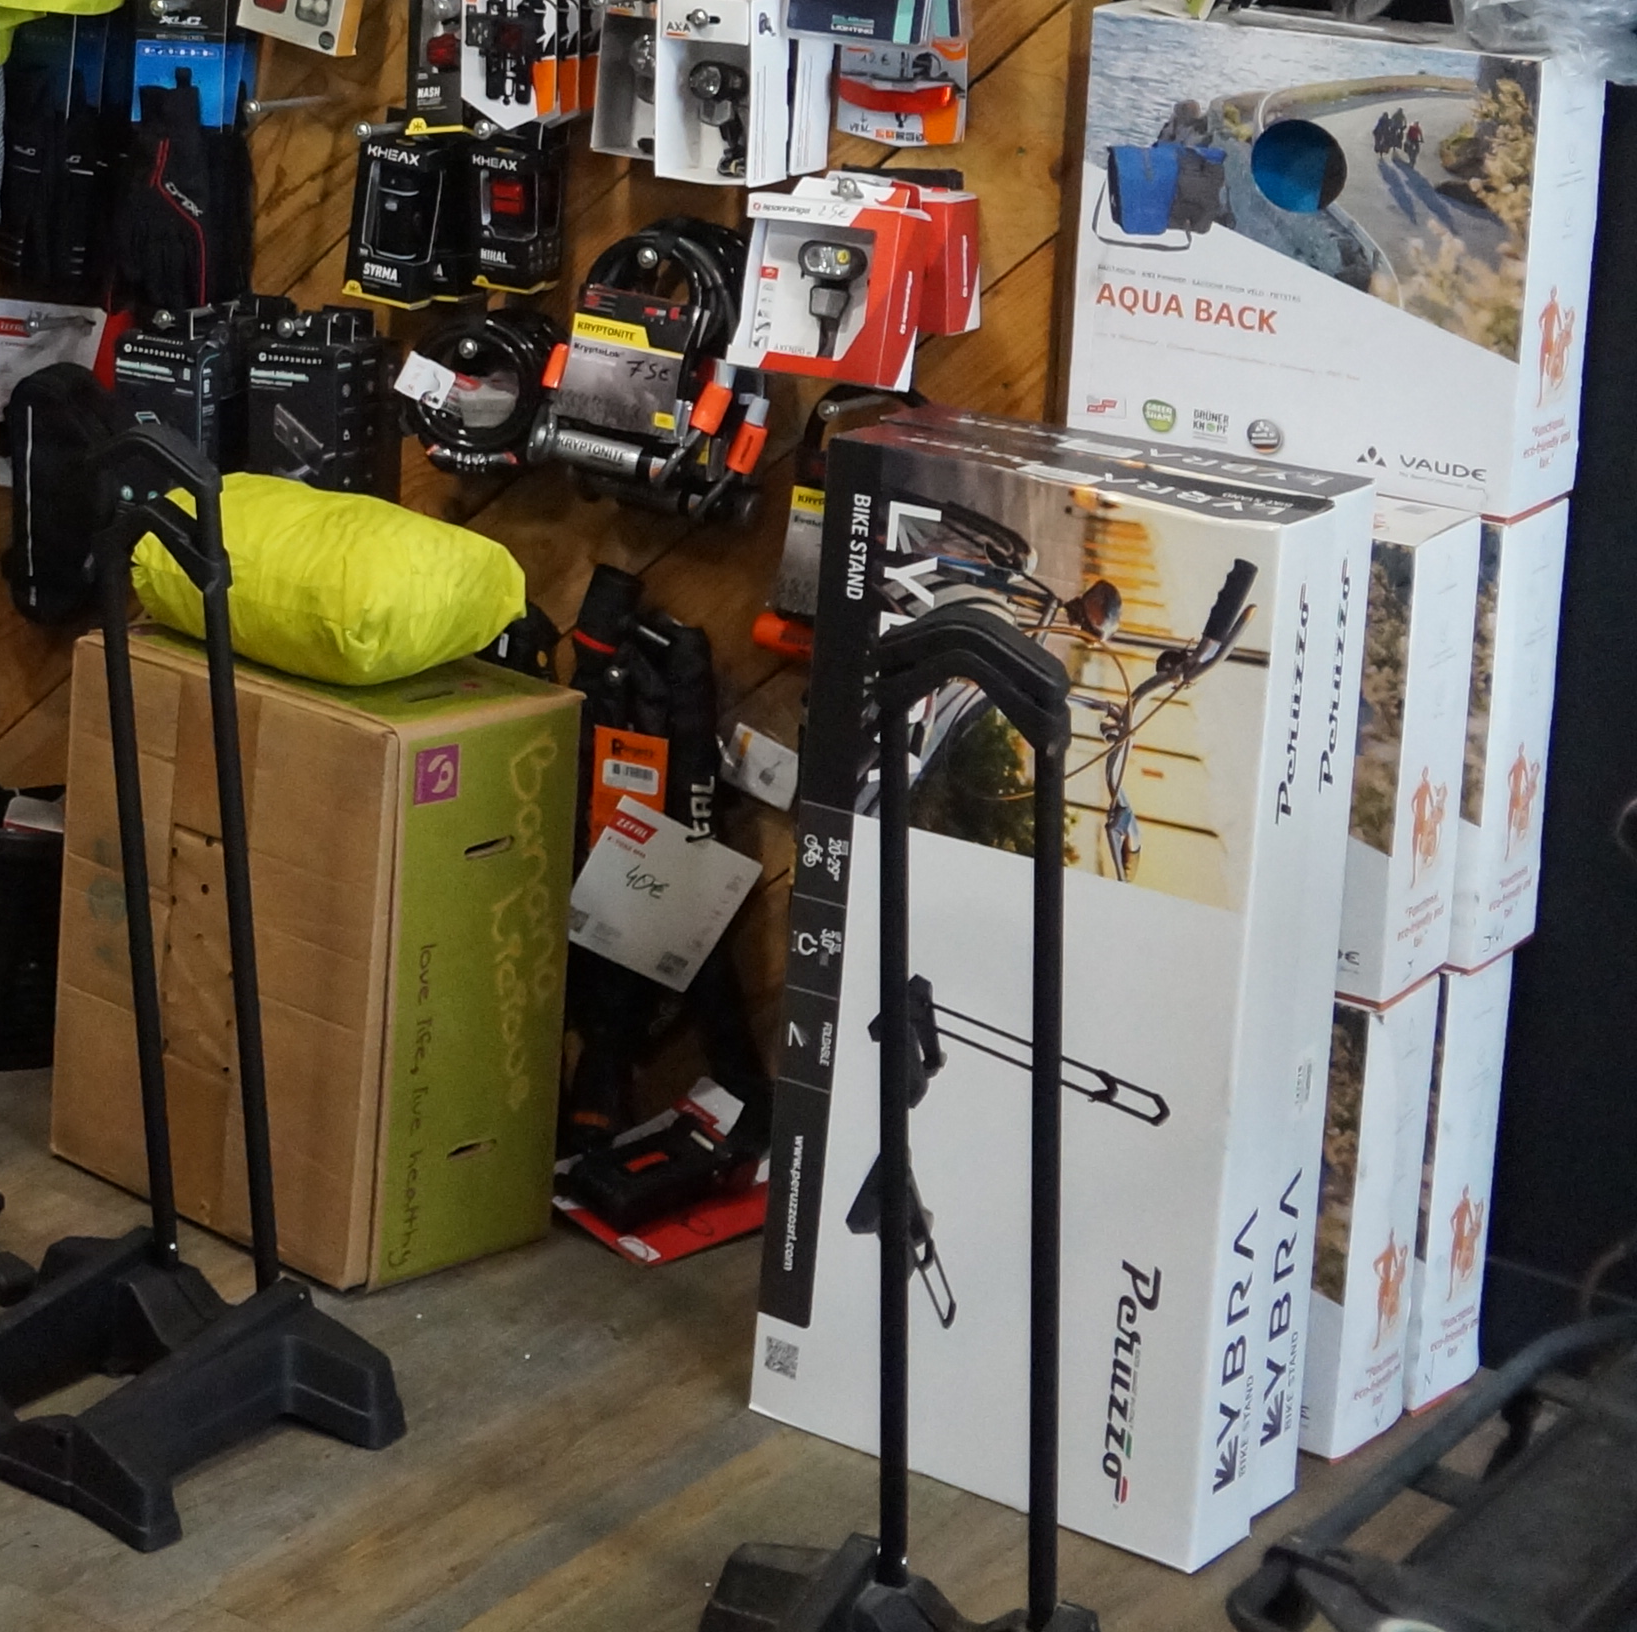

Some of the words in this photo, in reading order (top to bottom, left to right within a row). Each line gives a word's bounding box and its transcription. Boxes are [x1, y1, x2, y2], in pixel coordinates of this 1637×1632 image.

[666, 21, 691, 33] AXA
[417, 86, 441, 99] NASH
[367, 144, 420, 167] KHEAX
[472, 153, 518, 171] KHEAX
[362, 261, 398, 282] SYRMA
[577, 320, 637, 342] KRYPTONITE
[1095, 282, 1184, 319] AQUA
[1194, 298, 1278, 335] BACK
[557, 435, 626, 463] KRYPTONITE
[1399, 453, 1487, 482] VAUDE
[850, 492, 873, 537] BIKE
[845, 540, 869, 601] STAND
[1319, 550, 1351, 795] Peruzzo
[1275, 577, 1311, 826] Peruzzo
[417, 942, 439, 1006] love
[819, 1021, 833, 1067] FOLDABLE
[410, 1086, 430, 1136] live
[388, 1148, 424, 1269] healthy
[783, 1134, 805, 1272] www.peruzzosrl.com
[1288, 1330, 1300, 1382] STAND
[1103, 1258, 1163, 1505] Peruzzo
[1241, 1373, 1256, 1430] STAND
[1284, 1385, 1296, 1432] BIKE
[1236, 1431, 1249, 1478] BIKE
